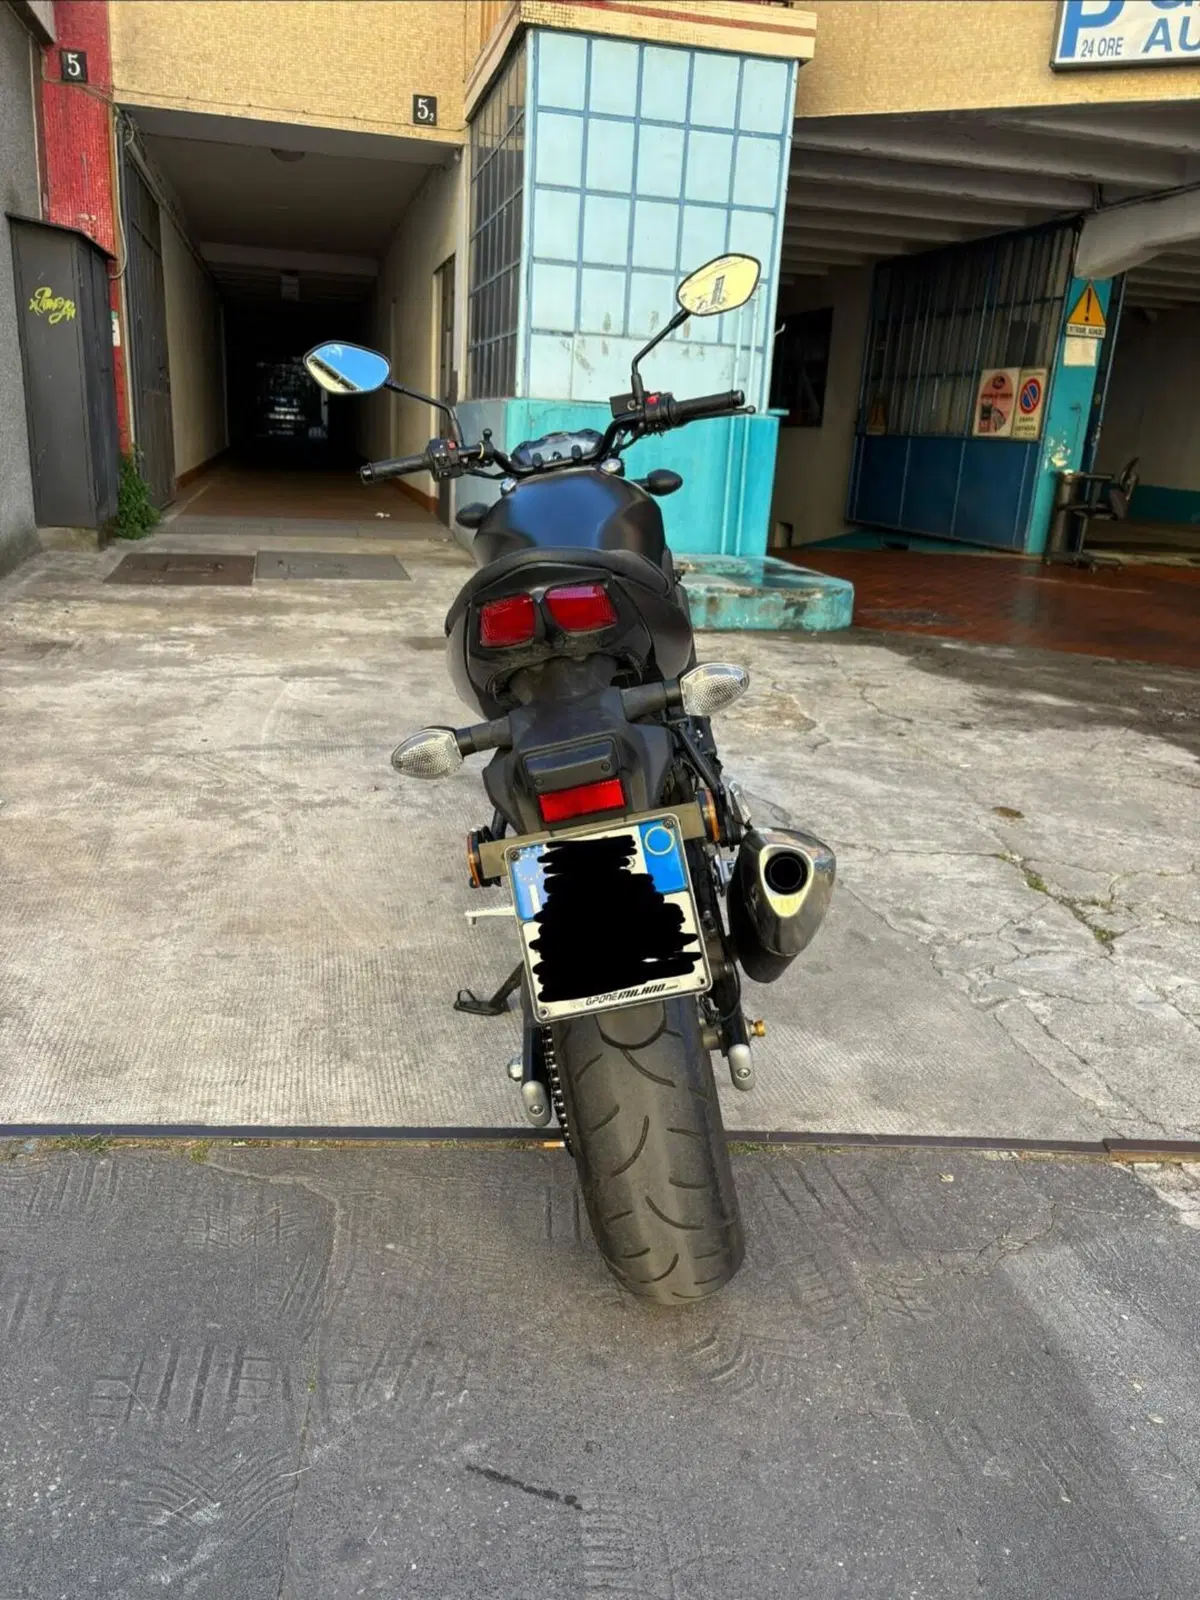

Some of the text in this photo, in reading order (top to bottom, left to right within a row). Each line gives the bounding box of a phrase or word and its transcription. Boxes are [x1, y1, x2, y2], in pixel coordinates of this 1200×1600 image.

[1081, 37, 1124, 57] 24 ORE
[67, 53, 80, 76] 5
